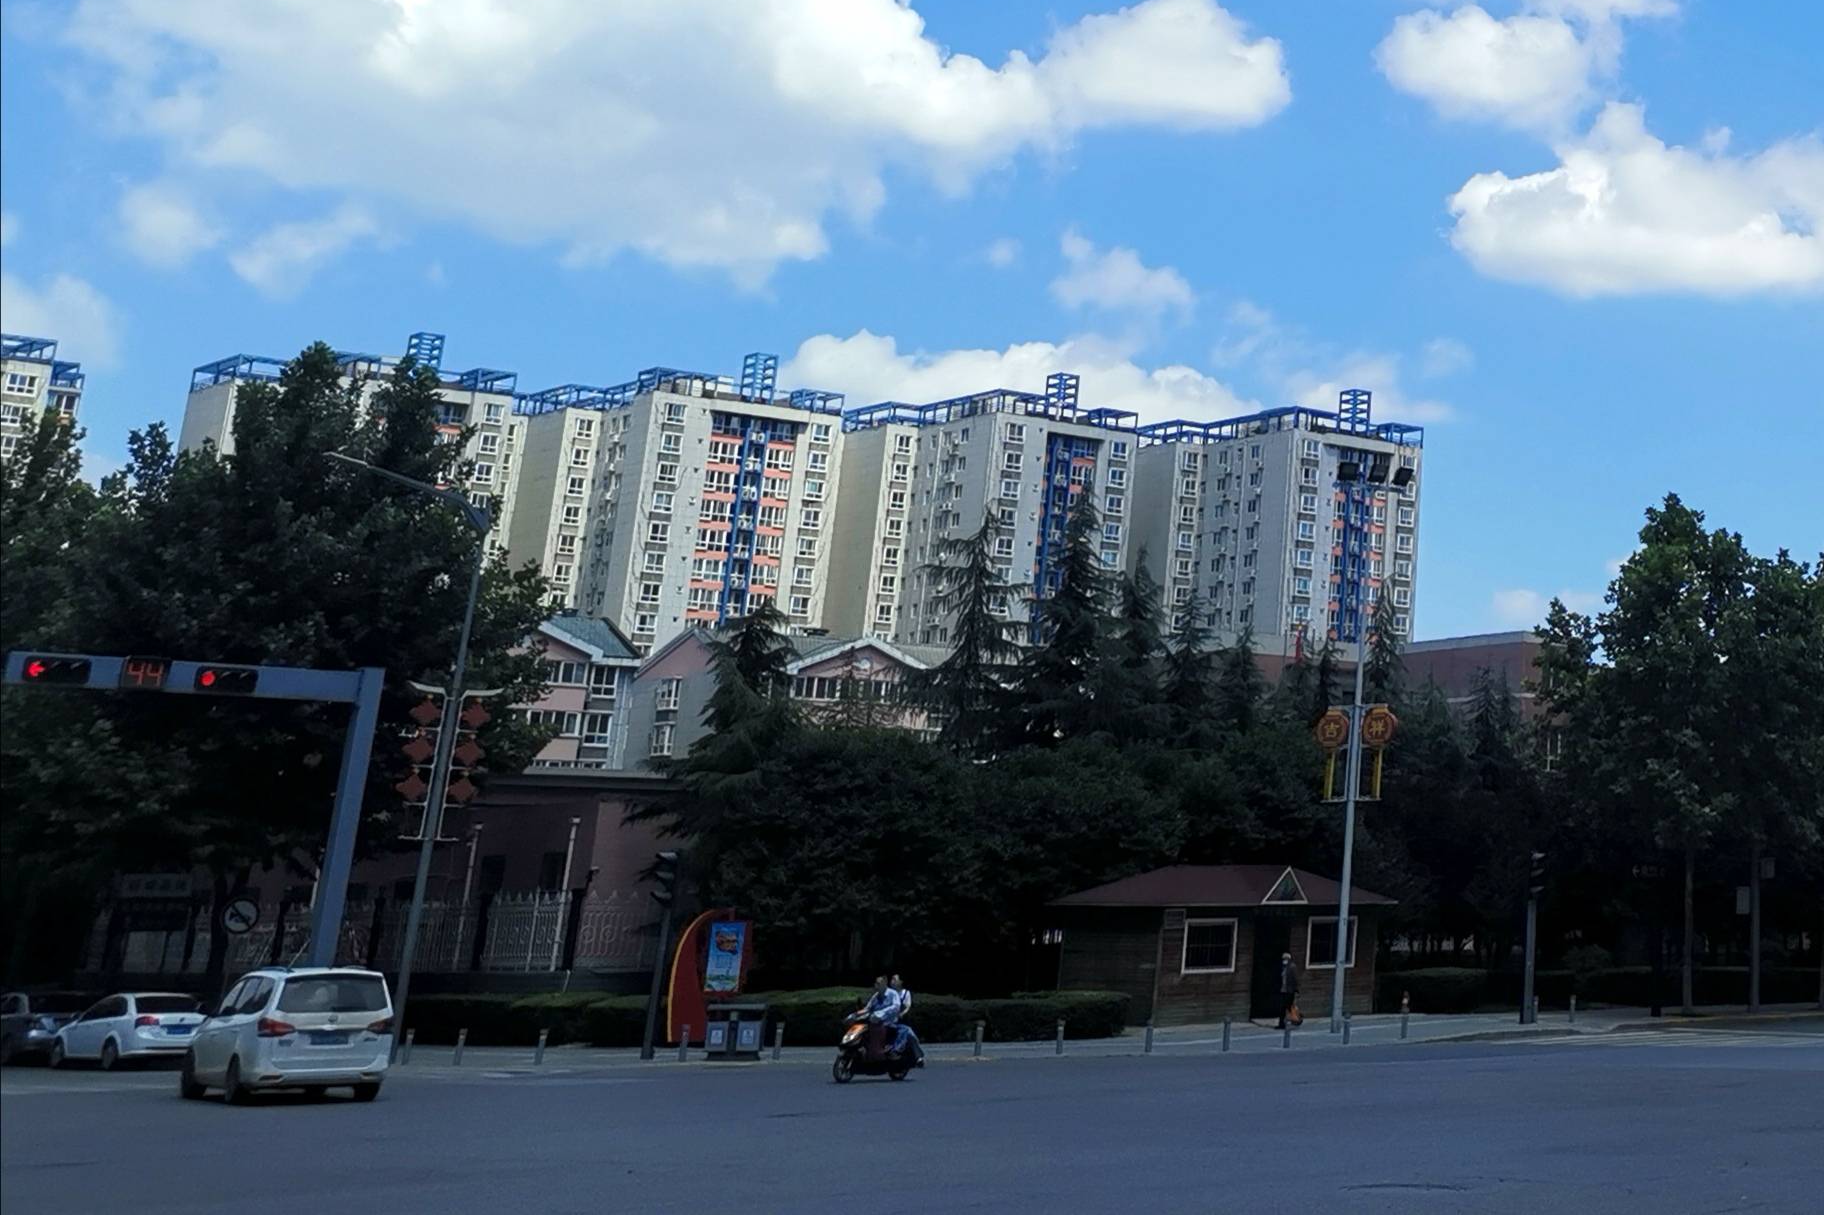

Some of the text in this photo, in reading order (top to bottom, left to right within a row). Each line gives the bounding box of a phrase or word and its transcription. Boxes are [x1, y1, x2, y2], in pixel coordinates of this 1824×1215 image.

[127, 662, 164, 688] 44
[1323, 719, 1385, 738] 吉 祥
